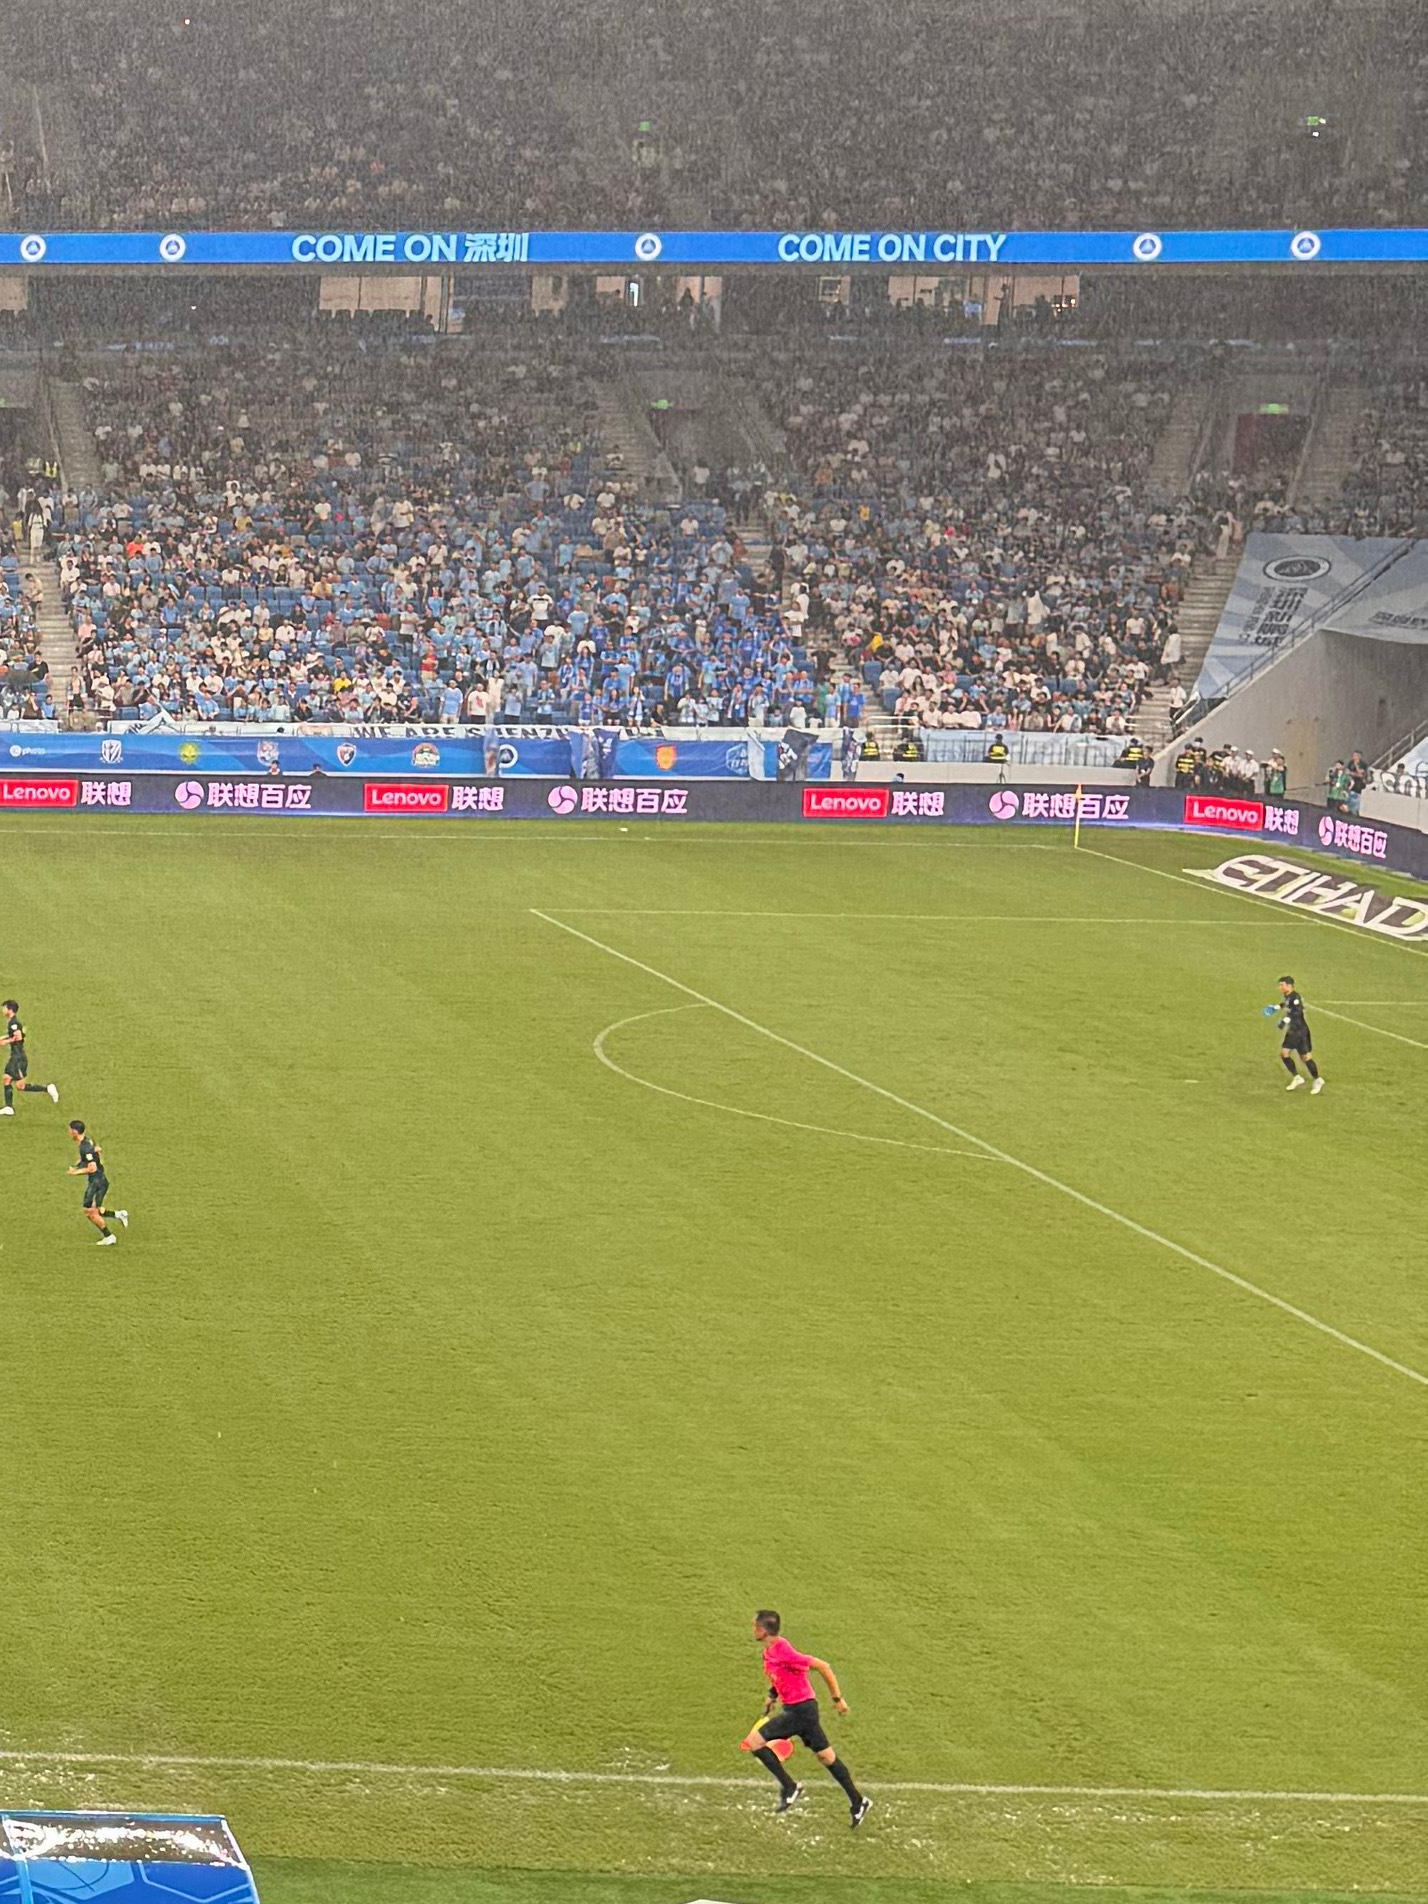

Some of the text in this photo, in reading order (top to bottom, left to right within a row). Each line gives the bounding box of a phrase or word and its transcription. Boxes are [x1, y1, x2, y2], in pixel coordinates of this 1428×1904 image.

[291, 232, 529, 263] COME ON 深圳
[777, 234, 1006, 262] COME ON CITY
[3, 781, 132, 807] Lenovo 联想
[207, 783, 312, 811] 联想百应
[372, 786, 505, 811] Lenovo 联想
[581, 786, 688, 815] 联想百应
[811, 791, 945, 817] Lenovo 联想
[1023, 790, 1130, 819] 联想百应
[1193, 801, 1300, 836] Lenovo 联想
[1334, 820, 1388, 859] 联想百应
[1215, 853, 1428, 943] ETIHAD
